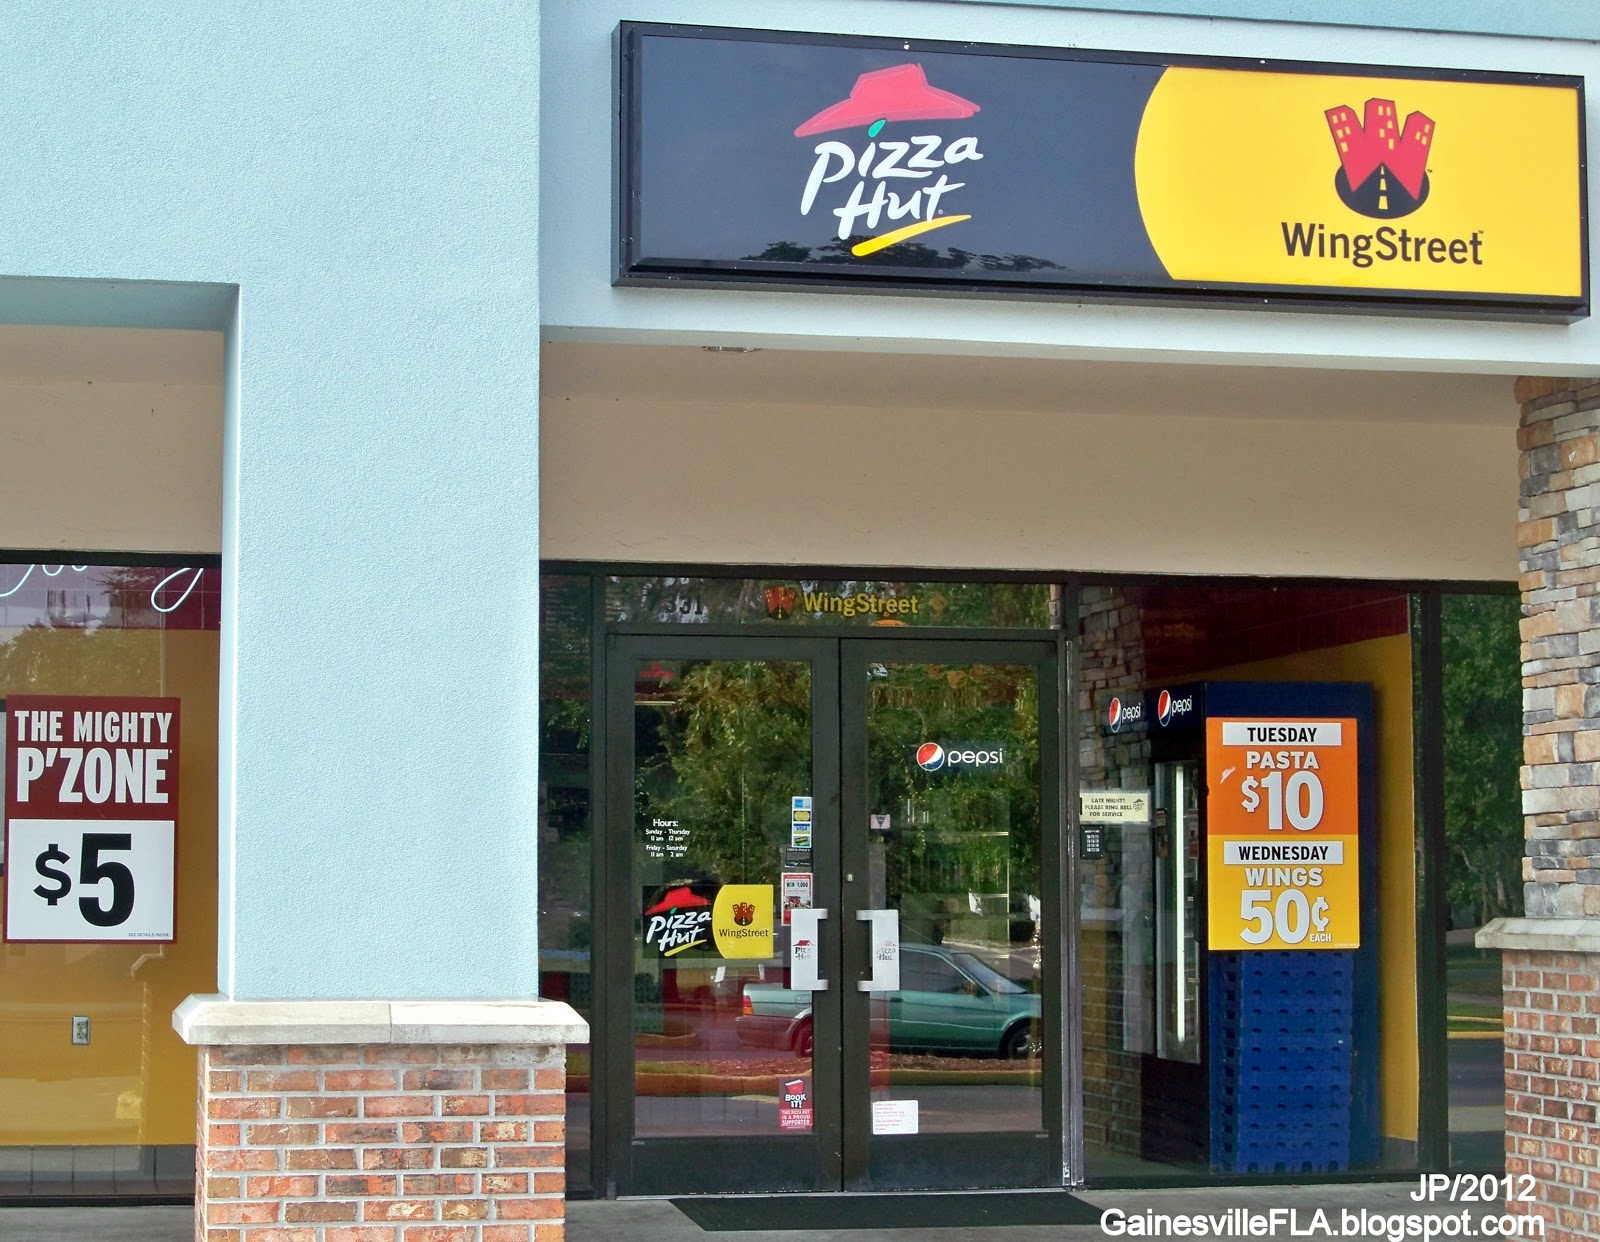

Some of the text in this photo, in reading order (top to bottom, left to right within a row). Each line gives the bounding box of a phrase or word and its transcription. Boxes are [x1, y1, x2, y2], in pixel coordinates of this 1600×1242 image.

[800, 120, 984, 216] Pizza
[833, 174, 966, 240] Hut
[1280, 221, 1484, 268] WingStreet
[803, 592, 919, 617] WingStreet
[1121, 702, 1141, 723] pepsi
[1171, 694, 1193, 717] pepsi
[14, 710, 173, 743] THE MIGHTY
[1247, 727, 1318, 743] TUESDAY
[947, 748, 1003, 767] pepsi
[1246, 751, 1320, 769] PASTA
[16, 747, 169, 804] P'ZONE
[1241, 770, 1324, 831] $10
[645, 828, 663, 836] Sunday
[668, 828, 691, 836] Thursday
[652, 818, 679, 827] Hours:
[1238, 846, 1329, 860] WEDNESDAY
[33, 832, 135, 927] $5
[1245, 867, 1323, 887] WINGS
[646, 907, 712, 944] Pizza
[1239, 888, 1330, 945] 50¢
[657, 926, 706, 952] Hut
[719, 928, 769, 938] WingStreet
[1310, 933, 1332, 942] EACH
